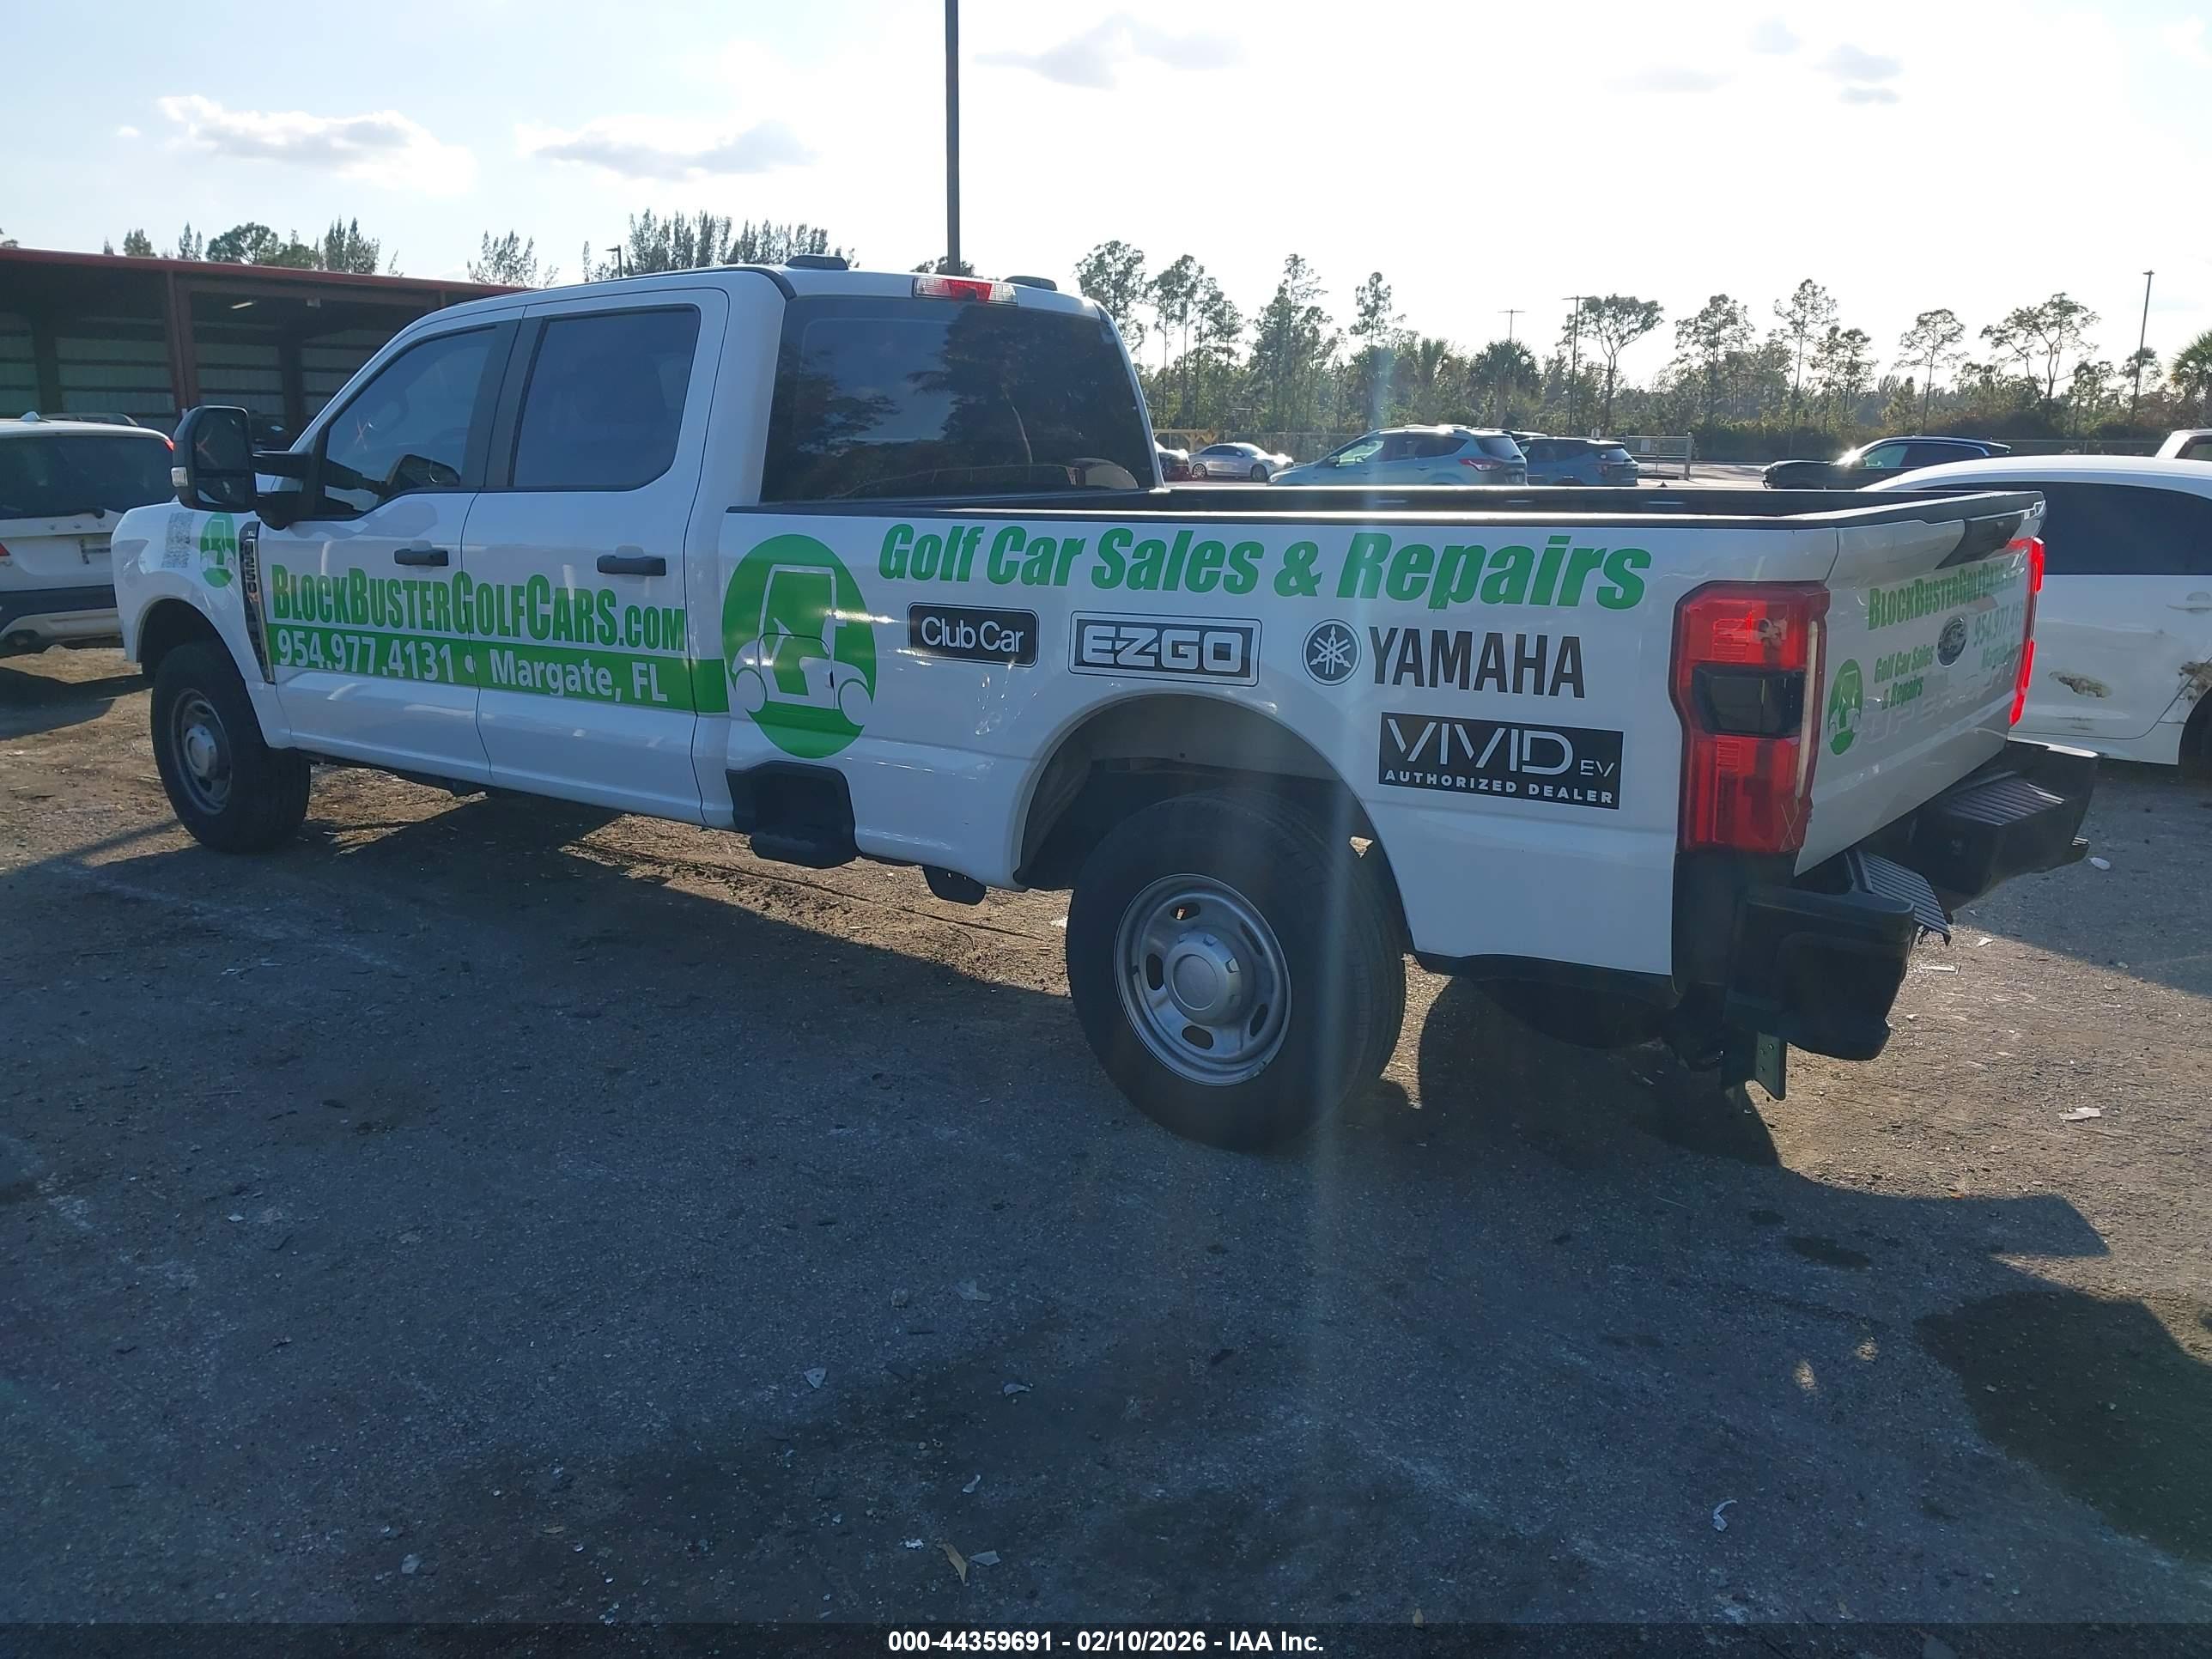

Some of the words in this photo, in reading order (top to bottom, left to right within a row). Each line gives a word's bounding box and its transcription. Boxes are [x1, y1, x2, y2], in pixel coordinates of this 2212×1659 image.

[878, 523, 985, 582] Golf
[987, 526, 1085, 587] Car
[1091, 527, 1265, 594] Sales
[1273, 541, 1322, 597] &
[1336, 532, 1652, 611] Repairs
[277, 629, 454, 684] 954.977.4131
[489, 648, 622, 702] Margate,
[631, 661, 668, 702] FL
[1083, 624, 1243, 672] EZGO
[1369, 625, 1585, 699] YAMAHA
[1875, 653, 1895, 684] Golf
[1895, 651, 1911, 677] Car
[1388, 718, 1574, 775] VIVID
[1579, 759, 1615, 777] EV
[1384, 769, 1517, 793] AUTHORIZED
[1528, 783, 1613, 804] DEALER
